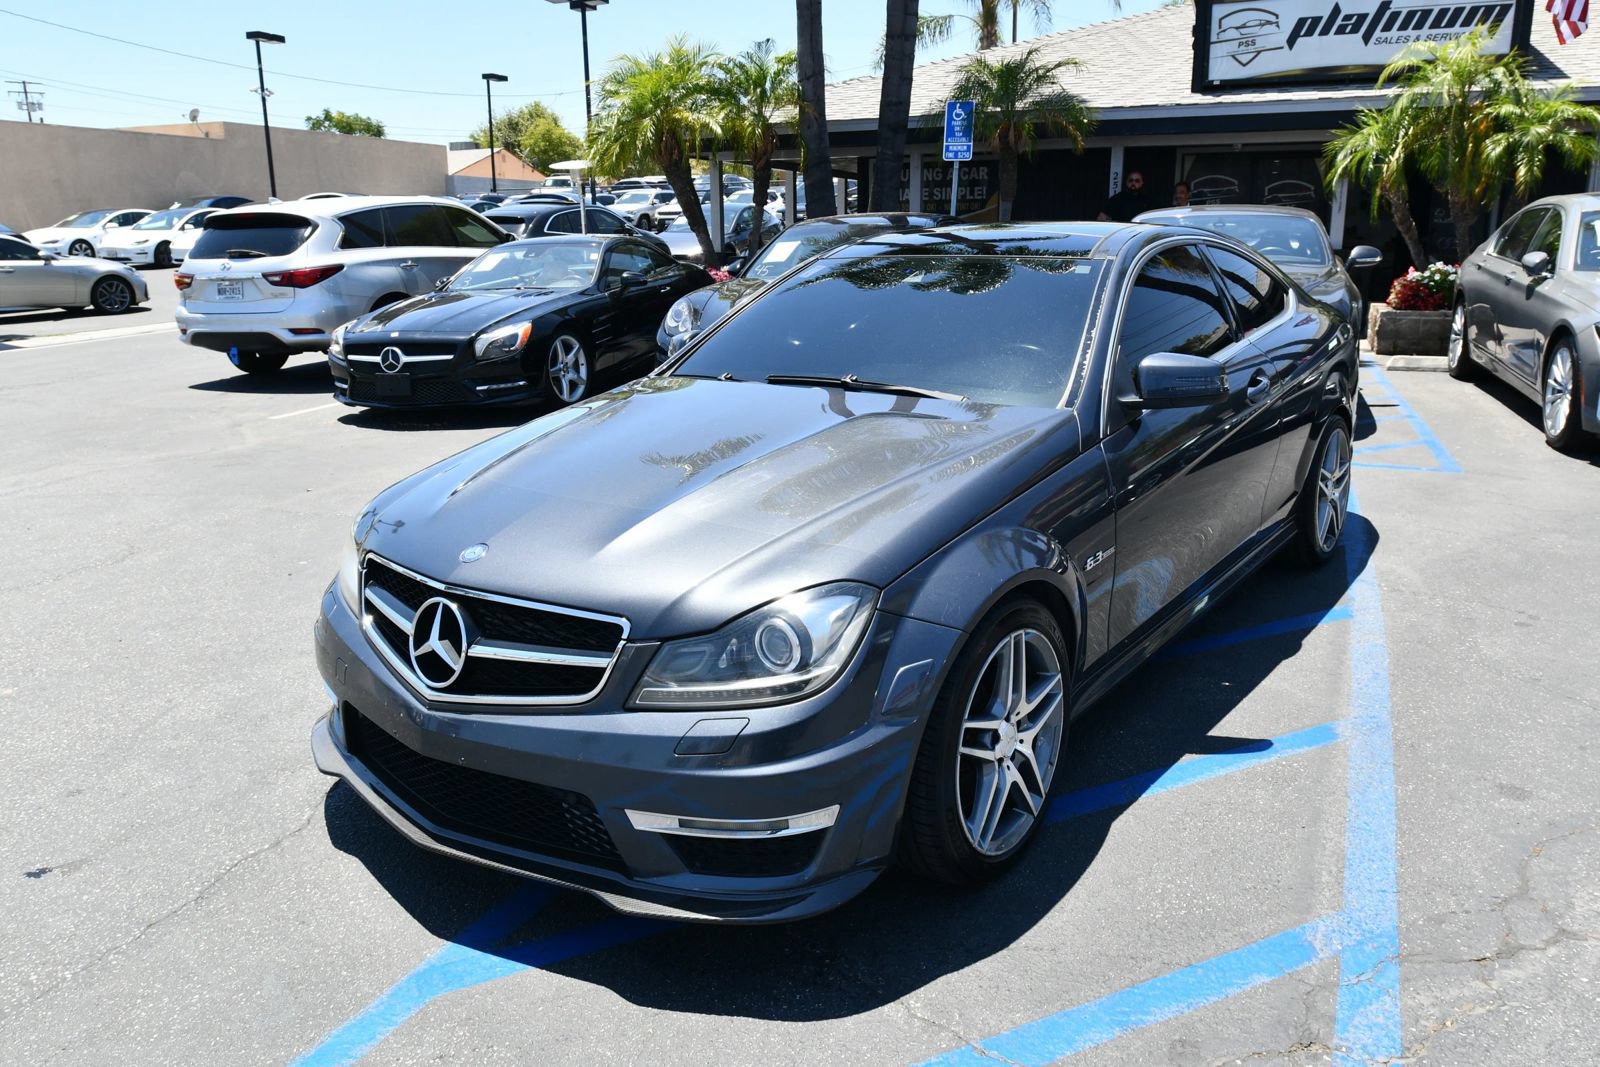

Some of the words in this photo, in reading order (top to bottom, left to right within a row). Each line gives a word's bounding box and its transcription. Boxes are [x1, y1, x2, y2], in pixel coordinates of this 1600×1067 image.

[1286, 0, 1514, 51] platinum
[1238, 38, 1257, 48] PSS
[1374, 34, 1410, 45] SALES
[1413, 33, 1423, 42] &
[1424, 31, 1474, 42] SERVI
[960, 166, 989, 180] CAR
[754, 265, 775, 277] 45
